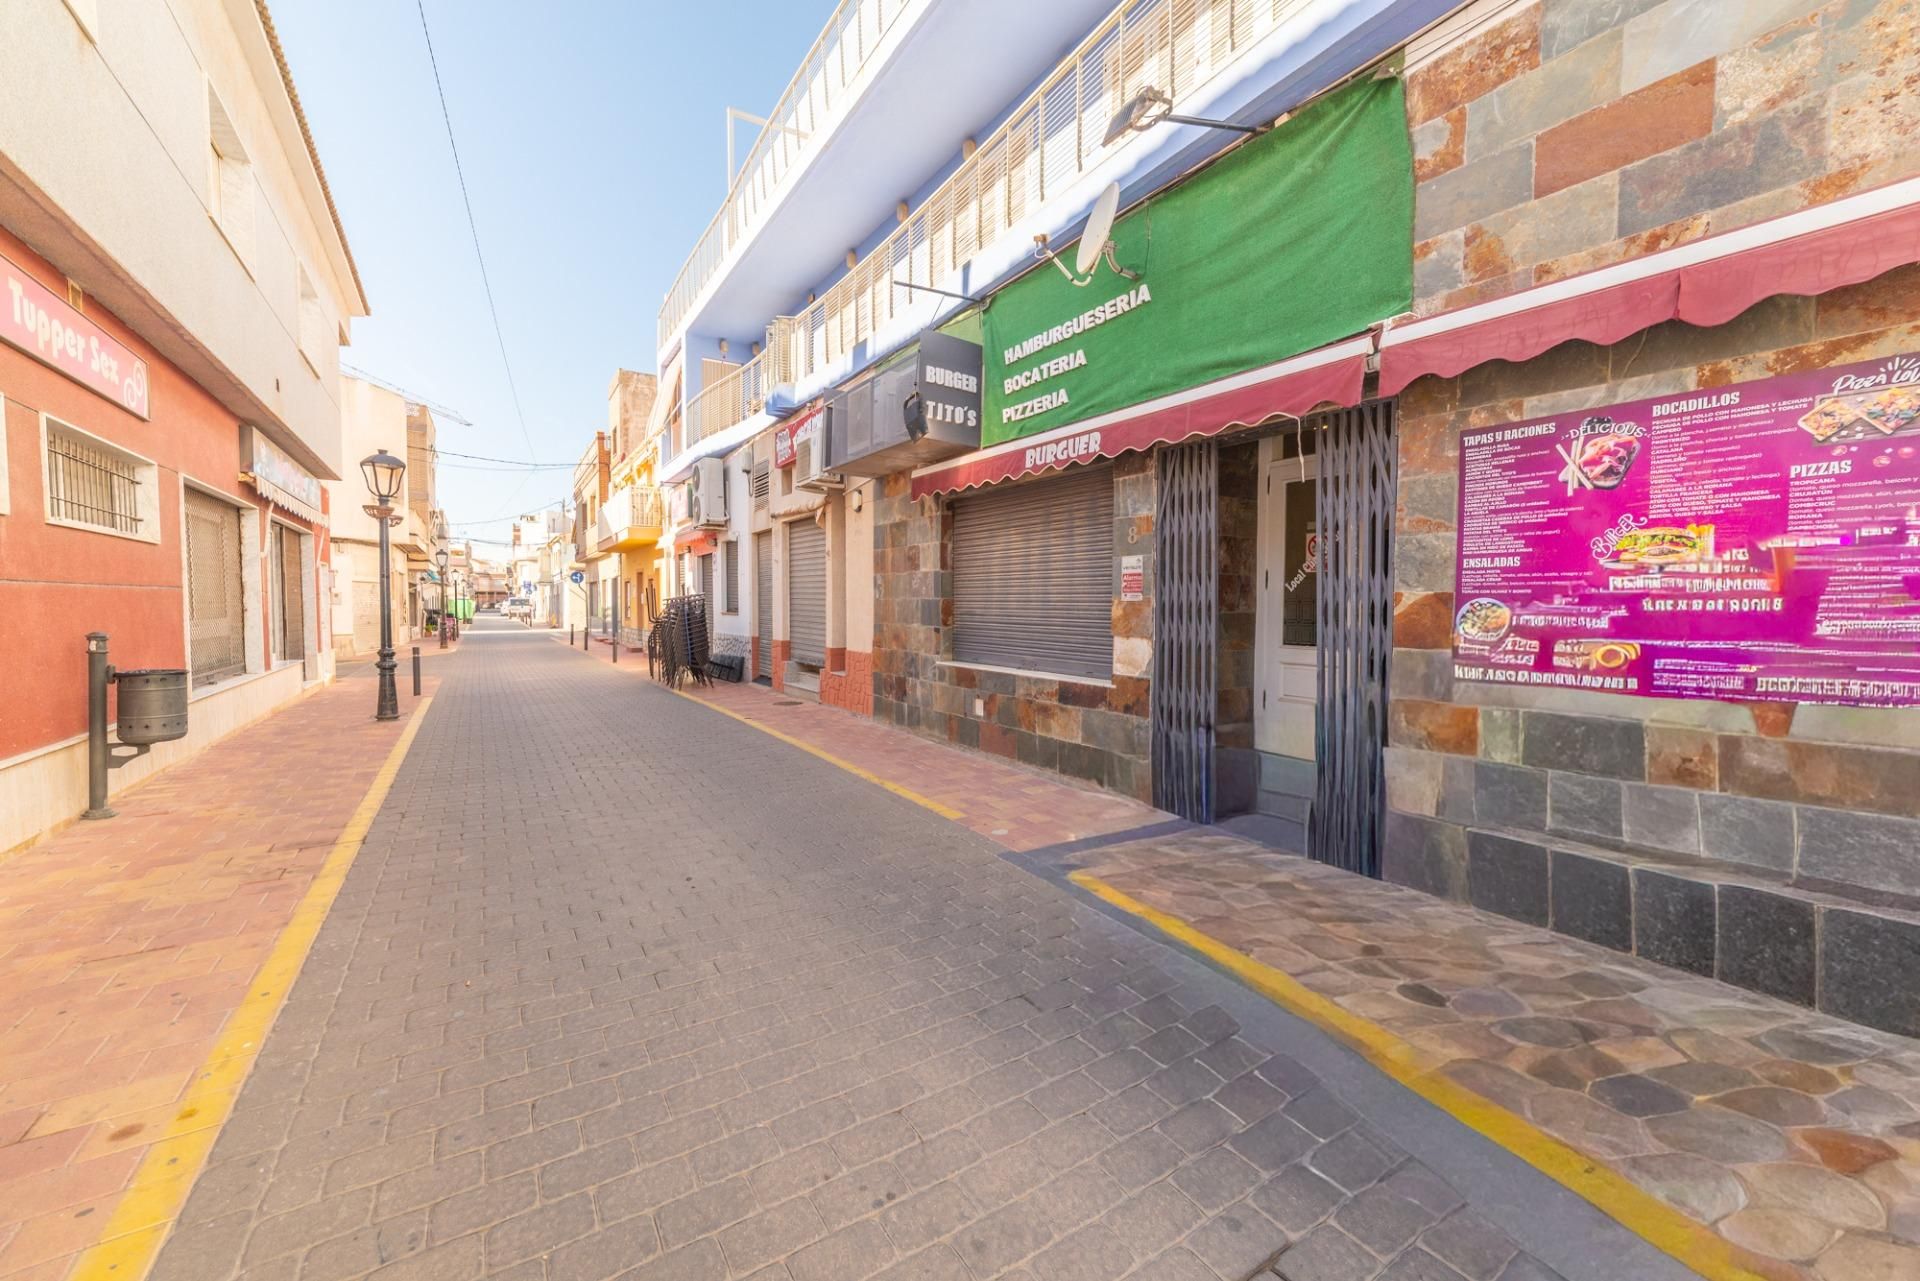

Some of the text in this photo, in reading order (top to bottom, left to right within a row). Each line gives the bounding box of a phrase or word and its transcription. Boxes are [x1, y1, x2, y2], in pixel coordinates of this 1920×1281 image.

[8, 276, 119, 385] Tupper Sex
[1004, 284, 1151, 365] HAMBURGUESERIA
[925, 365, 977, 394] BURGER
[1004, 349, 1087, 395] BOCATERIA
[1002, 388, 1069, 424] PIZZERIA
[1652, 392, 1740, 417] BOCADILLOS
[1692, 412, 1713, 420] POLLO
[1731, 404, 1769, 414] MAHONESA
[1731, 409, 1769, 419] MAHONESA
[1778, 403, 1808, 412] TOMATE
[1463, 431, 1493, 446] TAPAS
[1504, 422, 1556, 440] RACIONES
[1569, 423, 1646, 439] DELICIOUS
[1025, 431, 1101, 468] BURGUER
[1789, 460, 1852, 478] PIZZAS
[1128, 526, 1136, 544] 8
[1591, 513, 1648, 560] BURGER
[1463, 556, 1520, 568] ENSALADAS
[1285, 569, 1306, 592] Local
